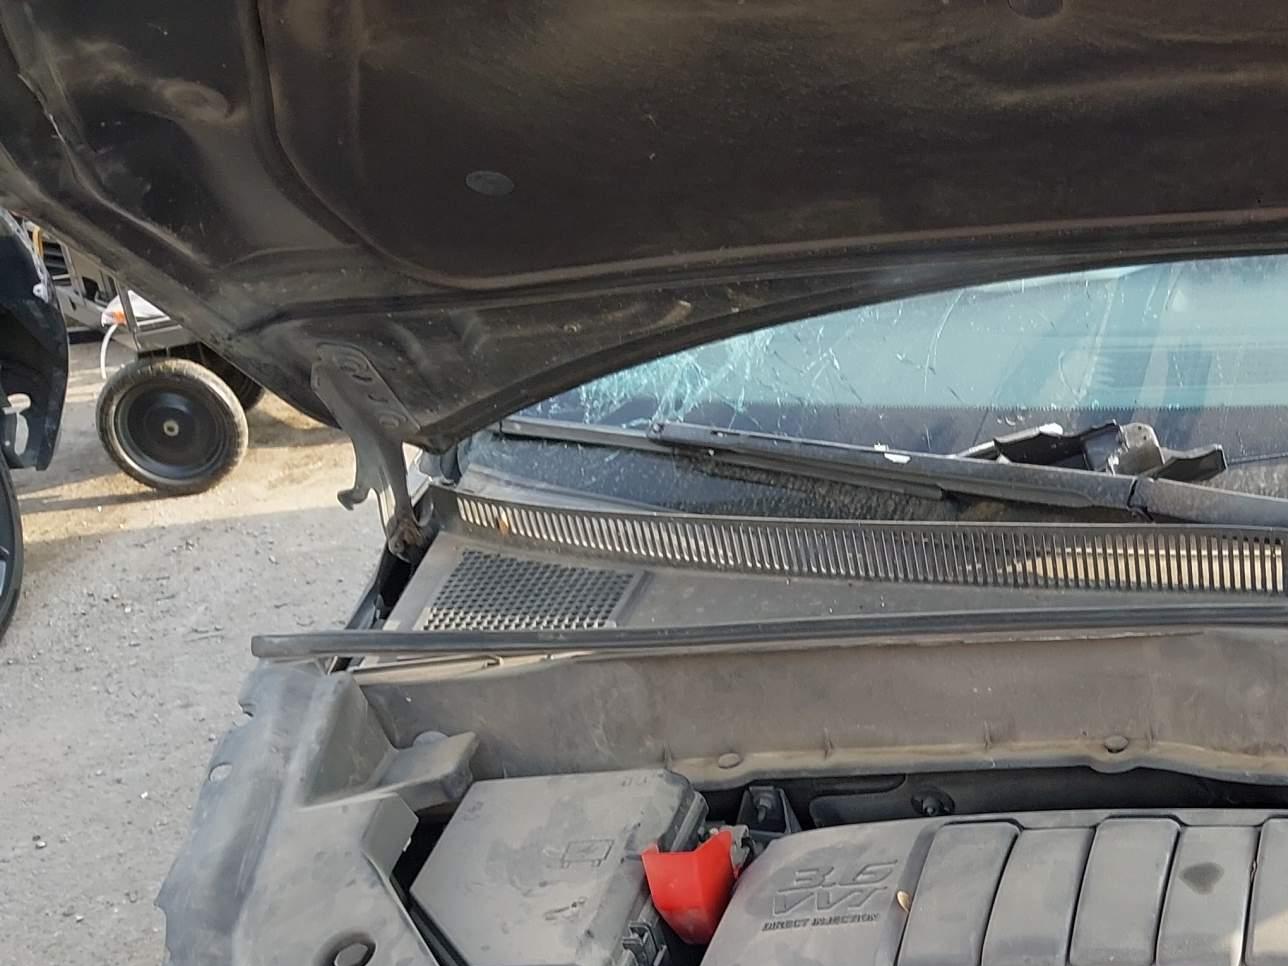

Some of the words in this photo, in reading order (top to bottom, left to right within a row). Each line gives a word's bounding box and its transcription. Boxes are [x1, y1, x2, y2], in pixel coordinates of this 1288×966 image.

[772, 886, 888, 916] VVT
[761, 918, 810, 931] DIRECT
[811, 913, 879, 927] INJECTION
